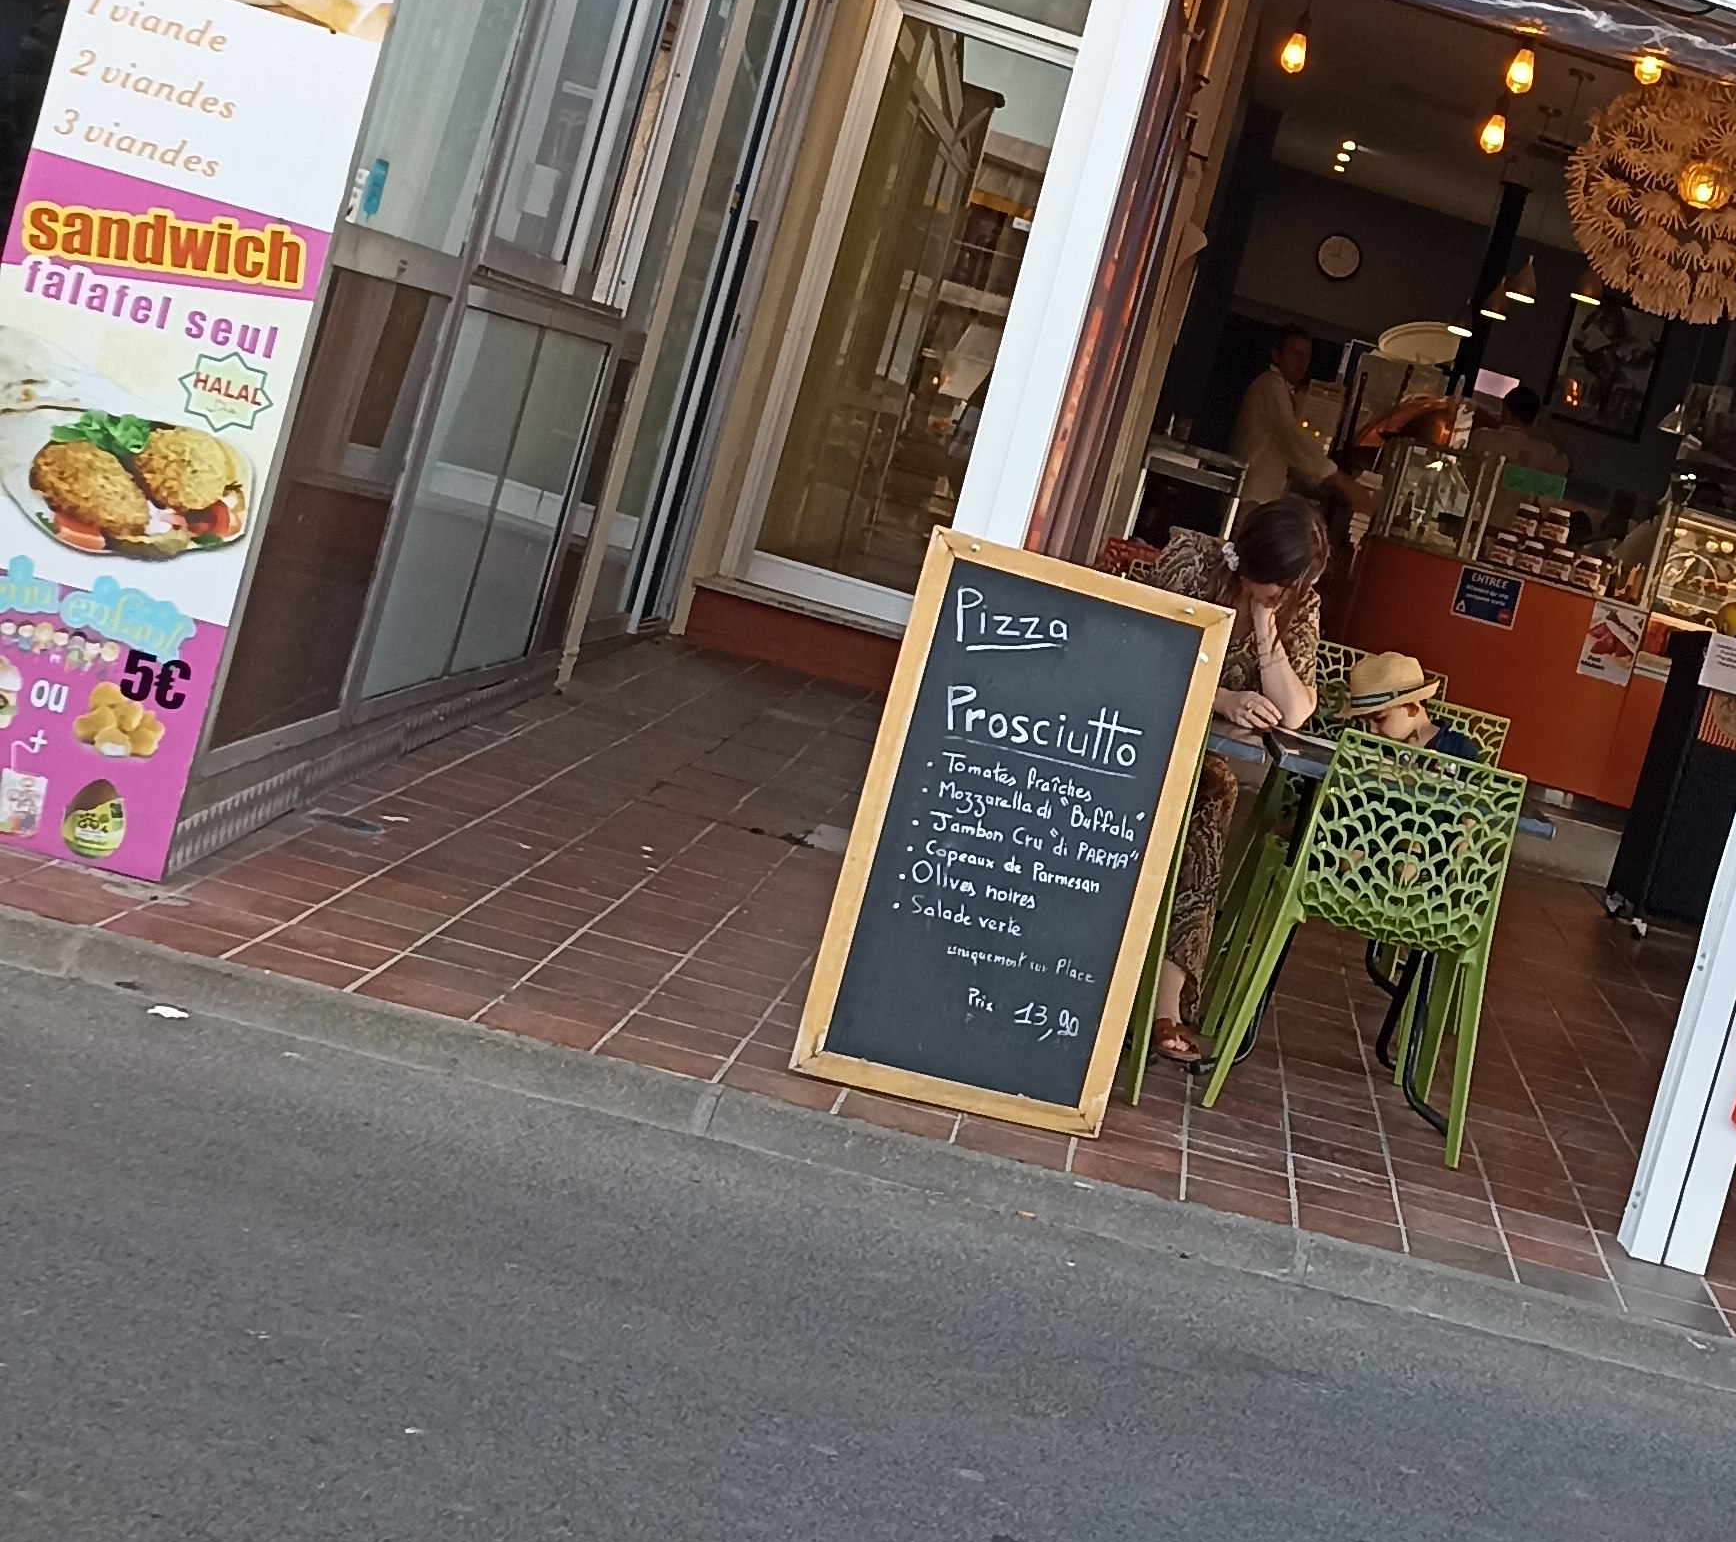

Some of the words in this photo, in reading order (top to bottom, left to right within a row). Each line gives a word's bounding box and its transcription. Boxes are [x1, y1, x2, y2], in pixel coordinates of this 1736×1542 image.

[109, 1, 228, 53] viande
[70, 49, 96, 77] 2
[102, 63, 237, 120] viandes
[53, 107, 80, 139] 3
[83, 121, 220, 179] viandes
[28, 206, 301, 284] sandwich
[23, 260, 172, 330] falafel
[184, 307, 280, 359] seul
[192, 371, 262, 408] HALAL
[956, 586, 1069, 643] Pizza
[120, 649, 192, 710] 5€
[947, 685, 1143, 767] Prosciutto
[939, 781, 1033, 817] Mozzarella
[1036, 799, 1052, 820] di
[1026, 767, 1092, 802] fraîches
[930, 810, 1004, 843] Jambon
[1012, 827, 1043, 851] Cru
[911, 859, 977, 897] Olives
[985, 884, 1036, 910] noires
[925, 839, 996, 868] Copeaux
[1003, 855, 1023, 875] de
[1032, 861, 1101, 894] Parmesan
[911, 894, 973, 926] Salade
[978, 915, 1023, 937] verte
[1055, 958, 1097, 984] Place
